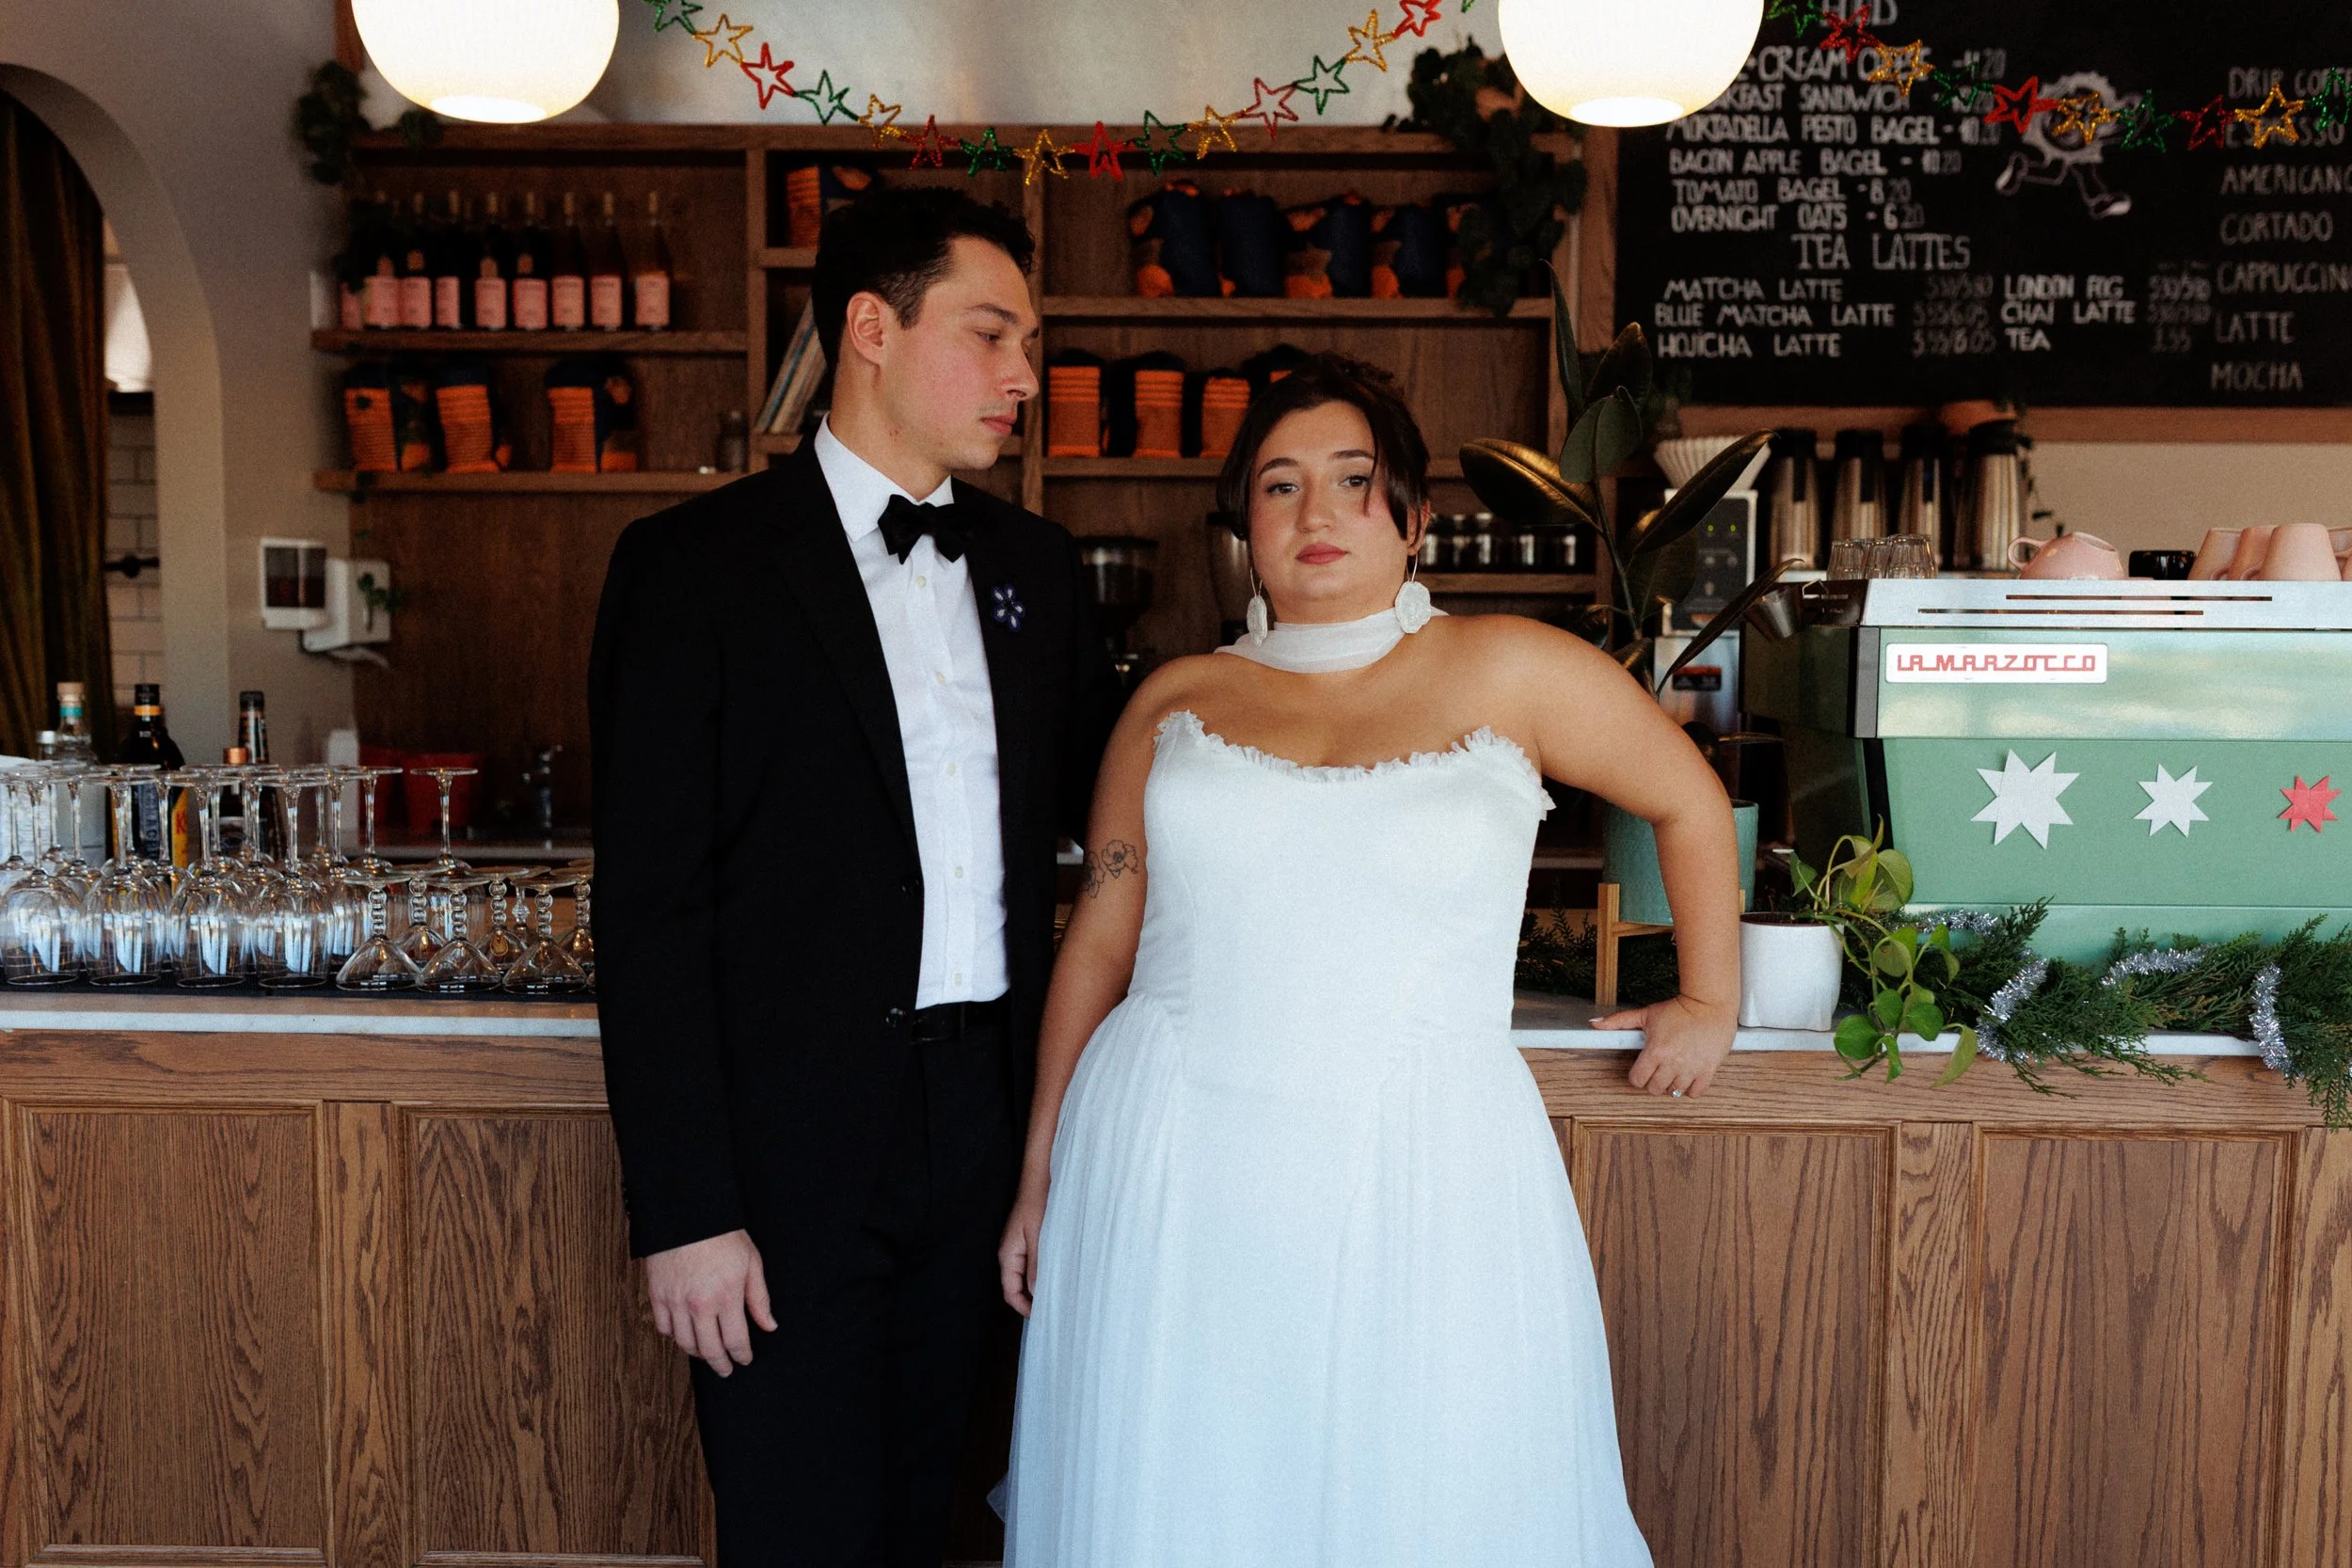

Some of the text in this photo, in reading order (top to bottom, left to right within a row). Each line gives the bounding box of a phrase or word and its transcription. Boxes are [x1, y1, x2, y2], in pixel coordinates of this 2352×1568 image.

[1757, 45, 1847, 82] CREAM
[2228, 67, 2284, 99] DRIP
[1801, 114, 1858, 144] PESTO
[1869, 114, 1940, 144] BAGEL
[1668, 148, 1735, 175] BACON
[1741, 149, 1802, 175] APPLE
[1819, 148, 1889, 176] BAGEL
[1671, 178, 1760, 204] TOMATO
[1776, 177, 1847, 203] BAGEL
[1670, 204, 1779, 233] OVERNIGHT
[1797, 202, 1848, 230] OATS
[2219, 211, 2335, 245] CORTADO
[1790, 232, 1971, 271] TEA LATTES
[1662, 277, 1844, 302] MATCHA LATTE
[2004, 274, 2075, 301] LONDON
[1654, 302, 1896, 327] BLUE MATCHA LATTE
[2000, 300, 2055, 325] CHAI
[2072, 299, 2136, 325] LATTE
[2004, 327, 2052, 352] TEA
[2215, 310, 2296, 344] LATTE
[1657, 331, 1842, 358] HOJICHA LATTE
[2210, 361, 2304, 391] MOCHA
[1935, 654, 2096, 672] MARZOCCO
